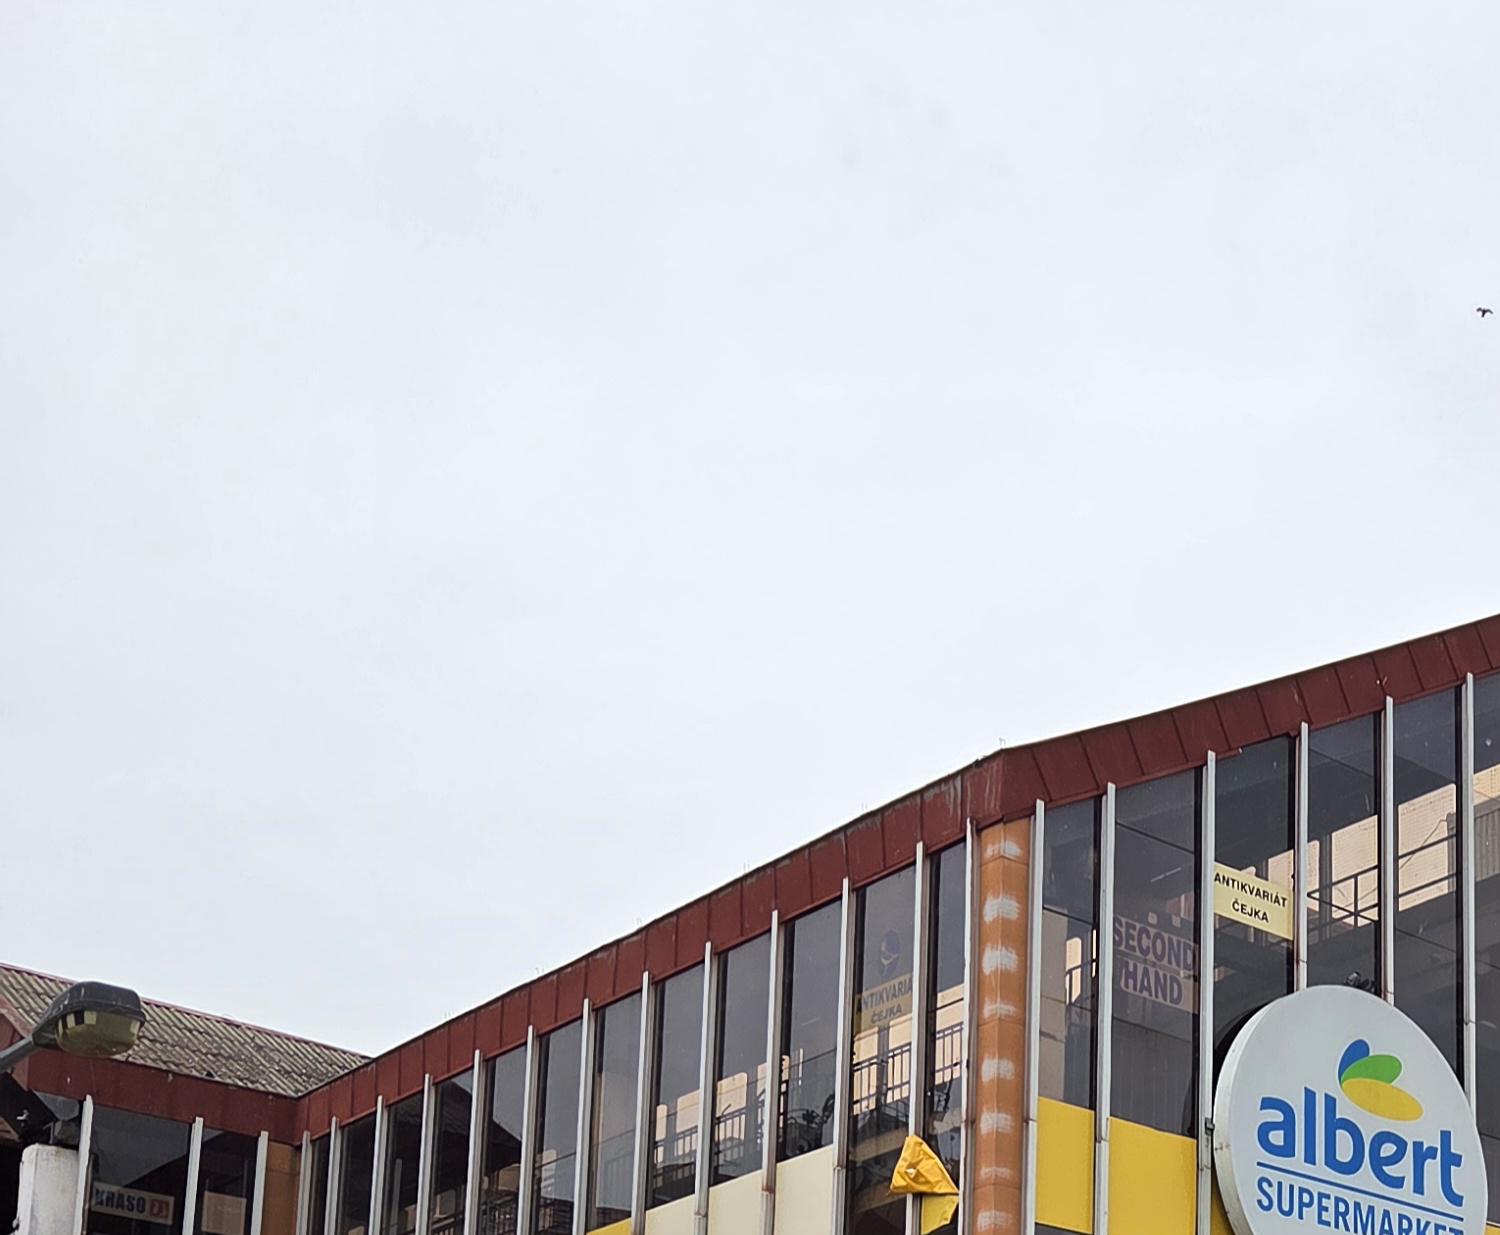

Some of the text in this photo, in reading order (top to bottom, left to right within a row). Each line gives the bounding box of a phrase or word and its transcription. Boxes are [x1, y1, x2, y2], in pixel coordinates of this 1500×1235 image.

[1213, 872, 1288, 908] ANTIKVARIÁT
[1232, 898, 1269, 923] ČEJKA
[1113, 915, 1198, 975] SECOND
[1121, 959, 1183, 1006] HAND
[1256, 1086, 1465, 1208] albert
